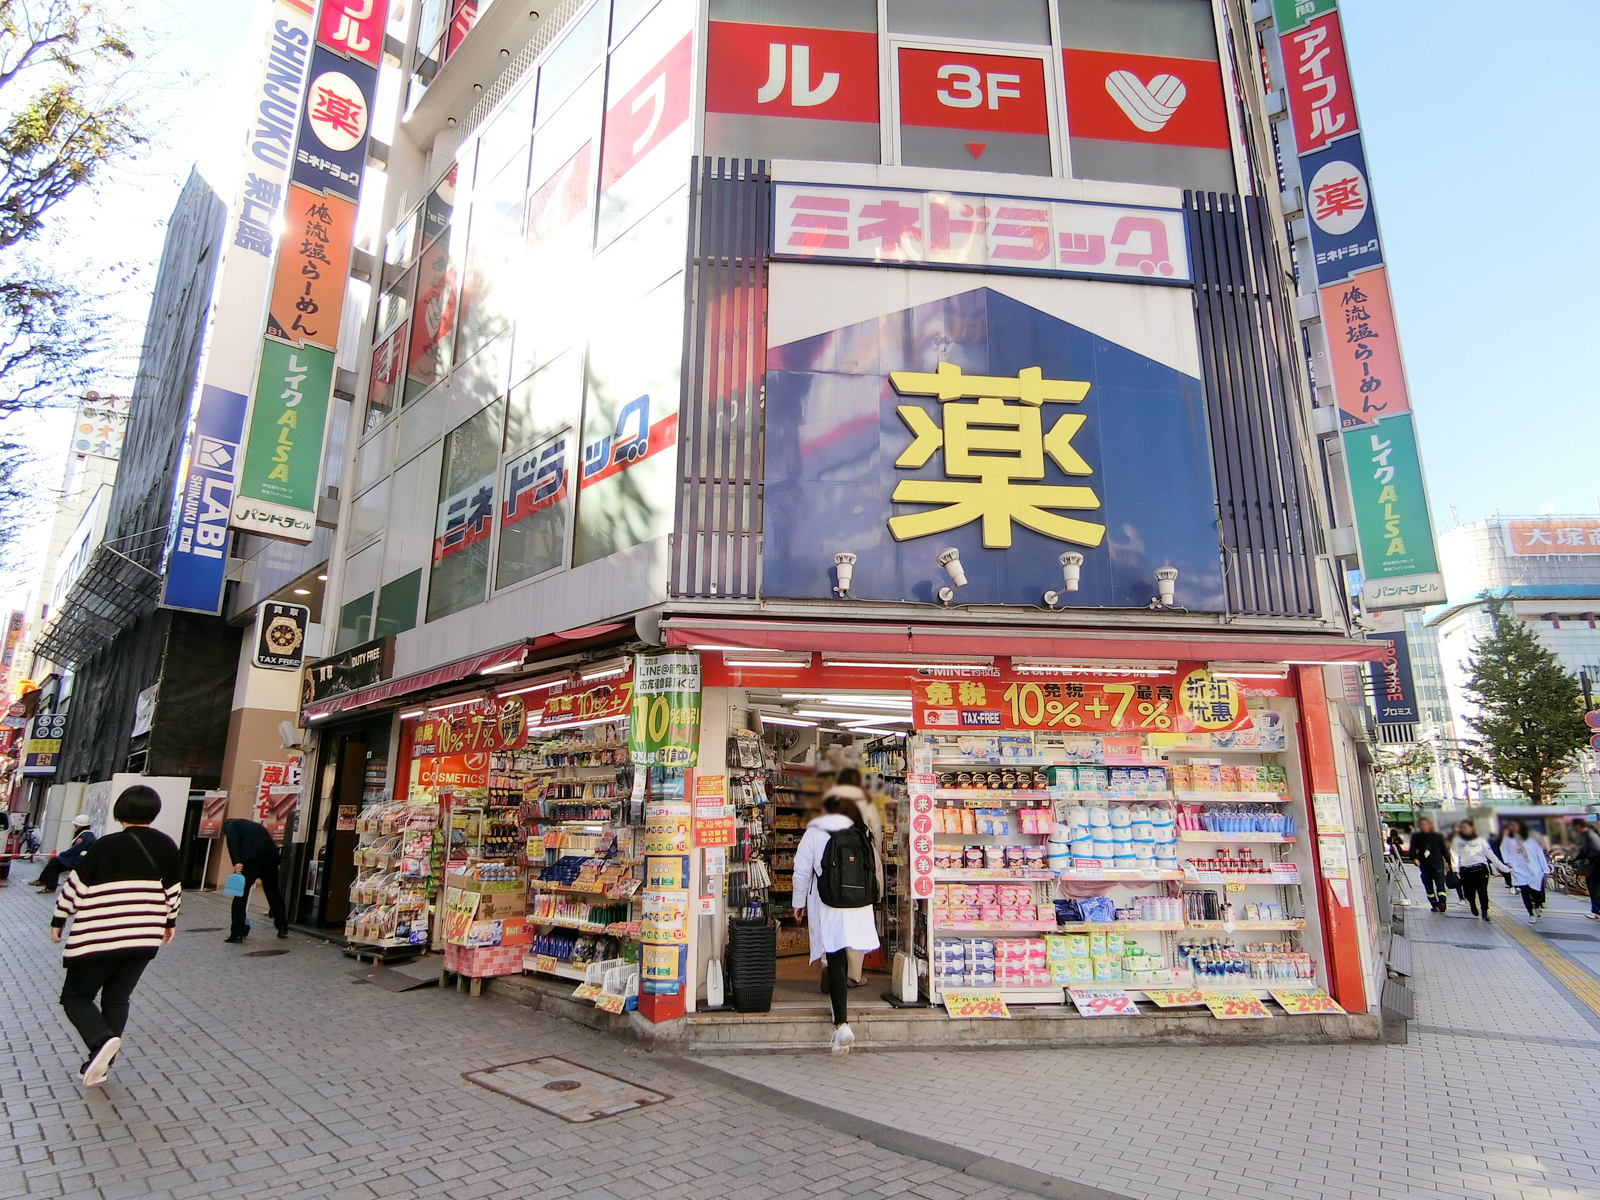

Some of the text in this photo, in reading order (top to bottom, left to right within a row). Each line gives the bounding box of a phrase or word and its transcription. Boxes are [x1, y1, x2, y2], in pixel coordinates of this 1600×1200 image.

[936, 64, 1021, 110] 3F
[1294, 25, 1345, 139] アイフル
[252, 19, 309, 171] SHINJUKU
[312, 86, 363, 140] 薬
[1313, 176, 1364, 221] 薬
[234, 172, 281, 259] 東口館
[292, 202, 334, 336] 俺流塩らーめん
[268, 326, 282, 336] B1
[1340, 286, 1387, 412] 俺流塩らーめん
[1343, 418, 1357, 427] B1
[886, 361, 1107, 549] 薬
[183, 474, 203, 525] SHINJUKU
[193, 477, 235, 559] LABI
[236, 509, 312, 530] パンドラビル
[1371, 583, 1438, 599] パンドラビル
[274, 605, 299, 617] 買取
[259, 655, 300, 666] TAX FREE
[352, 647, 380, 668] DUTY FREE
[925, 681, 986, 706] 免税
[1043, 683, 1084, 698] 免税
[1136, 685, 1173, 700] 最高
[1186, 677, 1230, 699] 折扣
[1187, 701, 1233, 723] 优惠
[1382, 707, 1412, 717] プロミス
[422, 771, 485, 784] COSMETICS
[1226, 883, 1246, 893] NEW
[960, 1001, 1003, 1015] 698
[1089, 997, 1129, 1012] 99
[1165, 991, 1202, 1004] 169
[1223, 1001, 1262, 1015] 298
[1295, 998, 1335, 1012] 298
